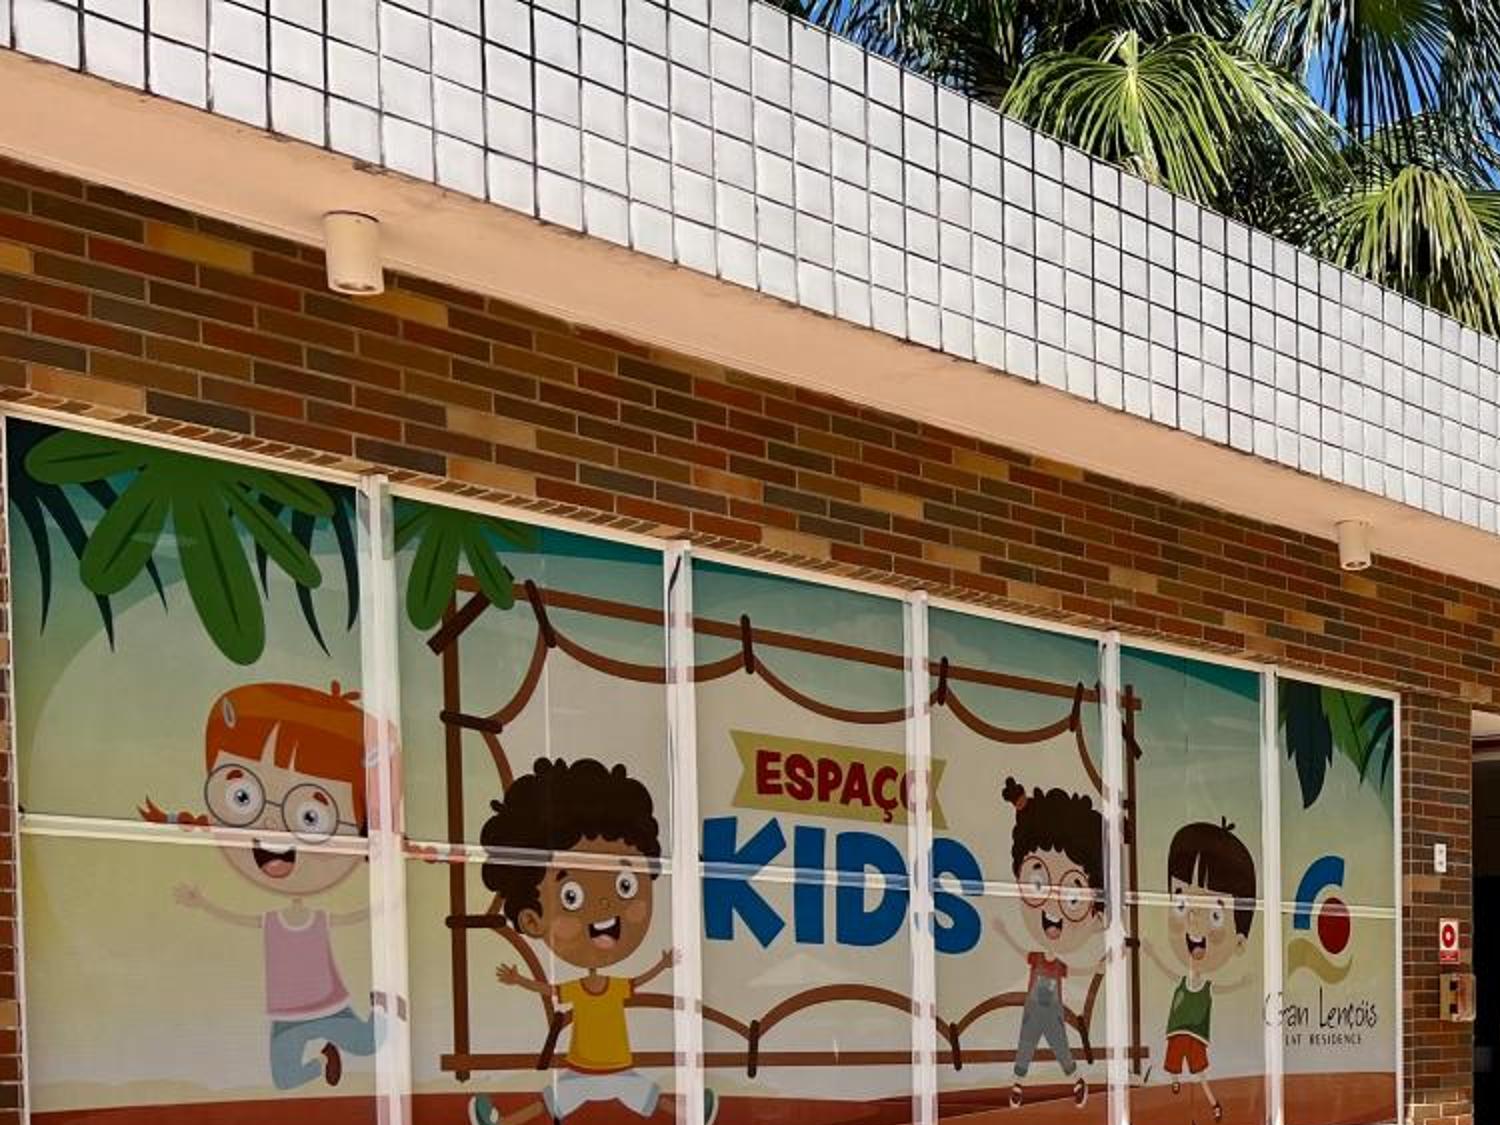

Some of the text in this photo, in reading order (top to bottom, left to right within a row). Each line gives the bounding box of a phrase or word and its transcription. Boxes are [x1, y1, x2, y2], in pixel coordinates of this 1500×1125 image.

[702, 815, 985, 955] KIDS
[1283, 1033, 1362, 1046] LAT RESIDENCE
